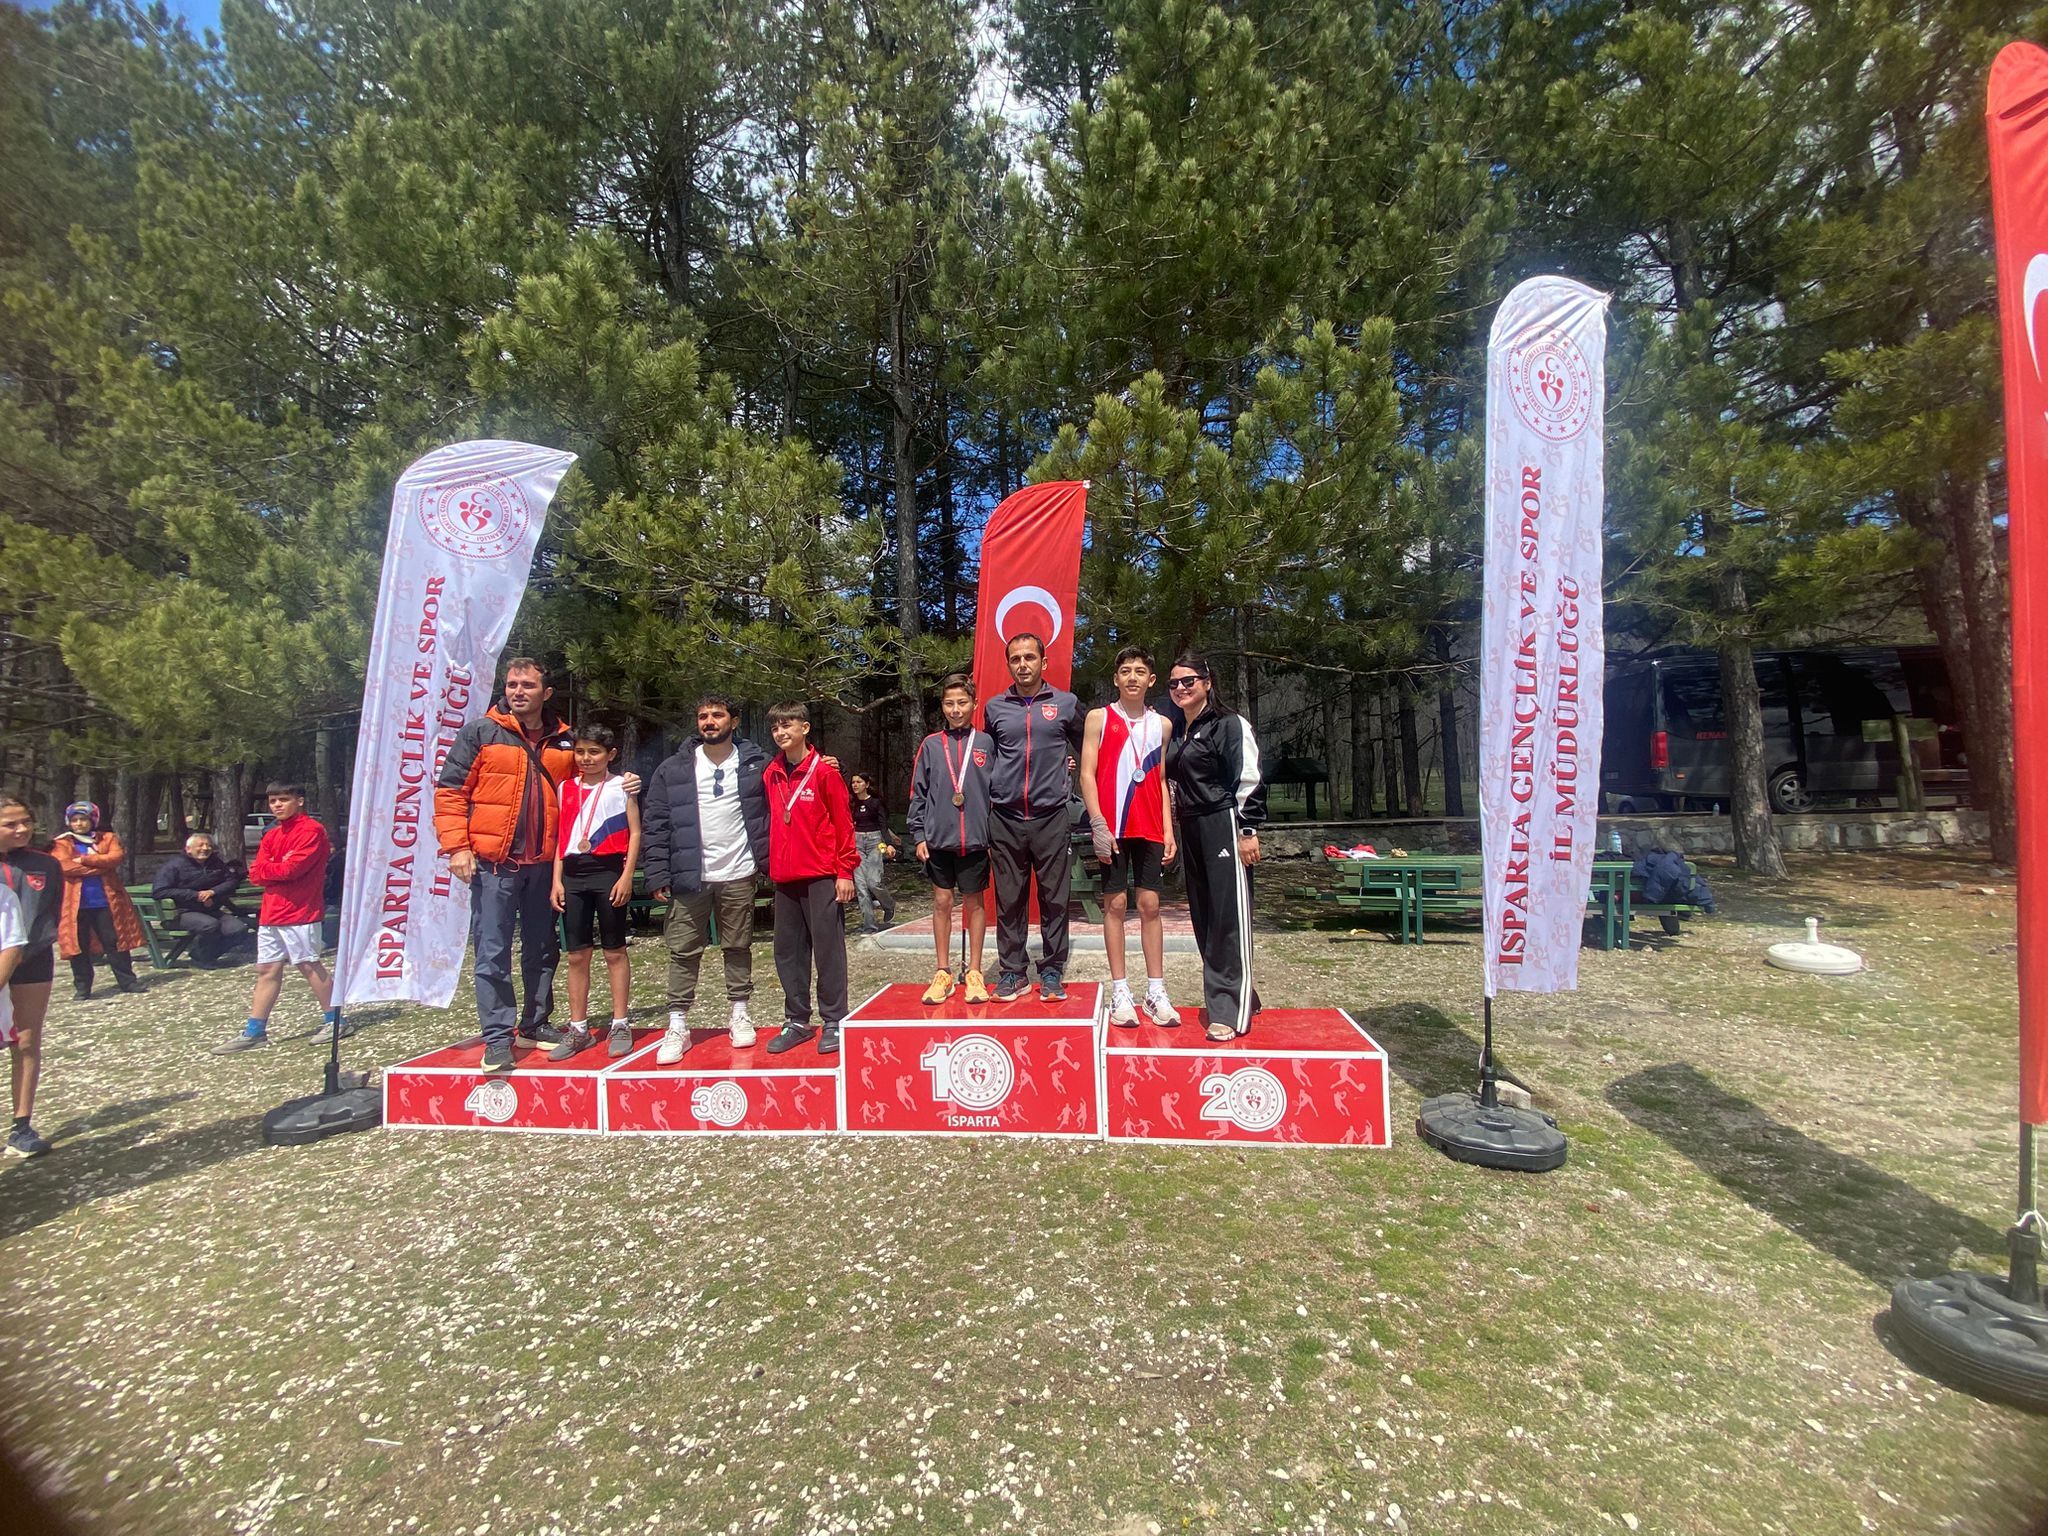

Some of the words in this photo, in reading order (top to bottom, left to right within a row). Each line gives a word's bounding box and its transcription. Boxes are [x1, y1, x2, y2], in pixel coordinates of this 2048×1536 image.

[1520, 466, 1541, 563] SPOR
[417, 576, 445, 654] SPOR
[1520, 570, 1537, 619] VE
[411, 661, 433, 701] VE
[1510, 629, 1541, 804] GENÇLİK
[1550, 572, 1579, 818] MÜDÜRLÜĞÜ
[391, 707, 426, 848] GENÇLİK
[429, 869, 452, 898] İL
[1549, 825, 1573, 864] İL
[376, 854, 415, 981] ISPARTA
[1498, 811, 1531, 967] ISPARTA
[948, 1115, 1000, 1127] ISPARTA
